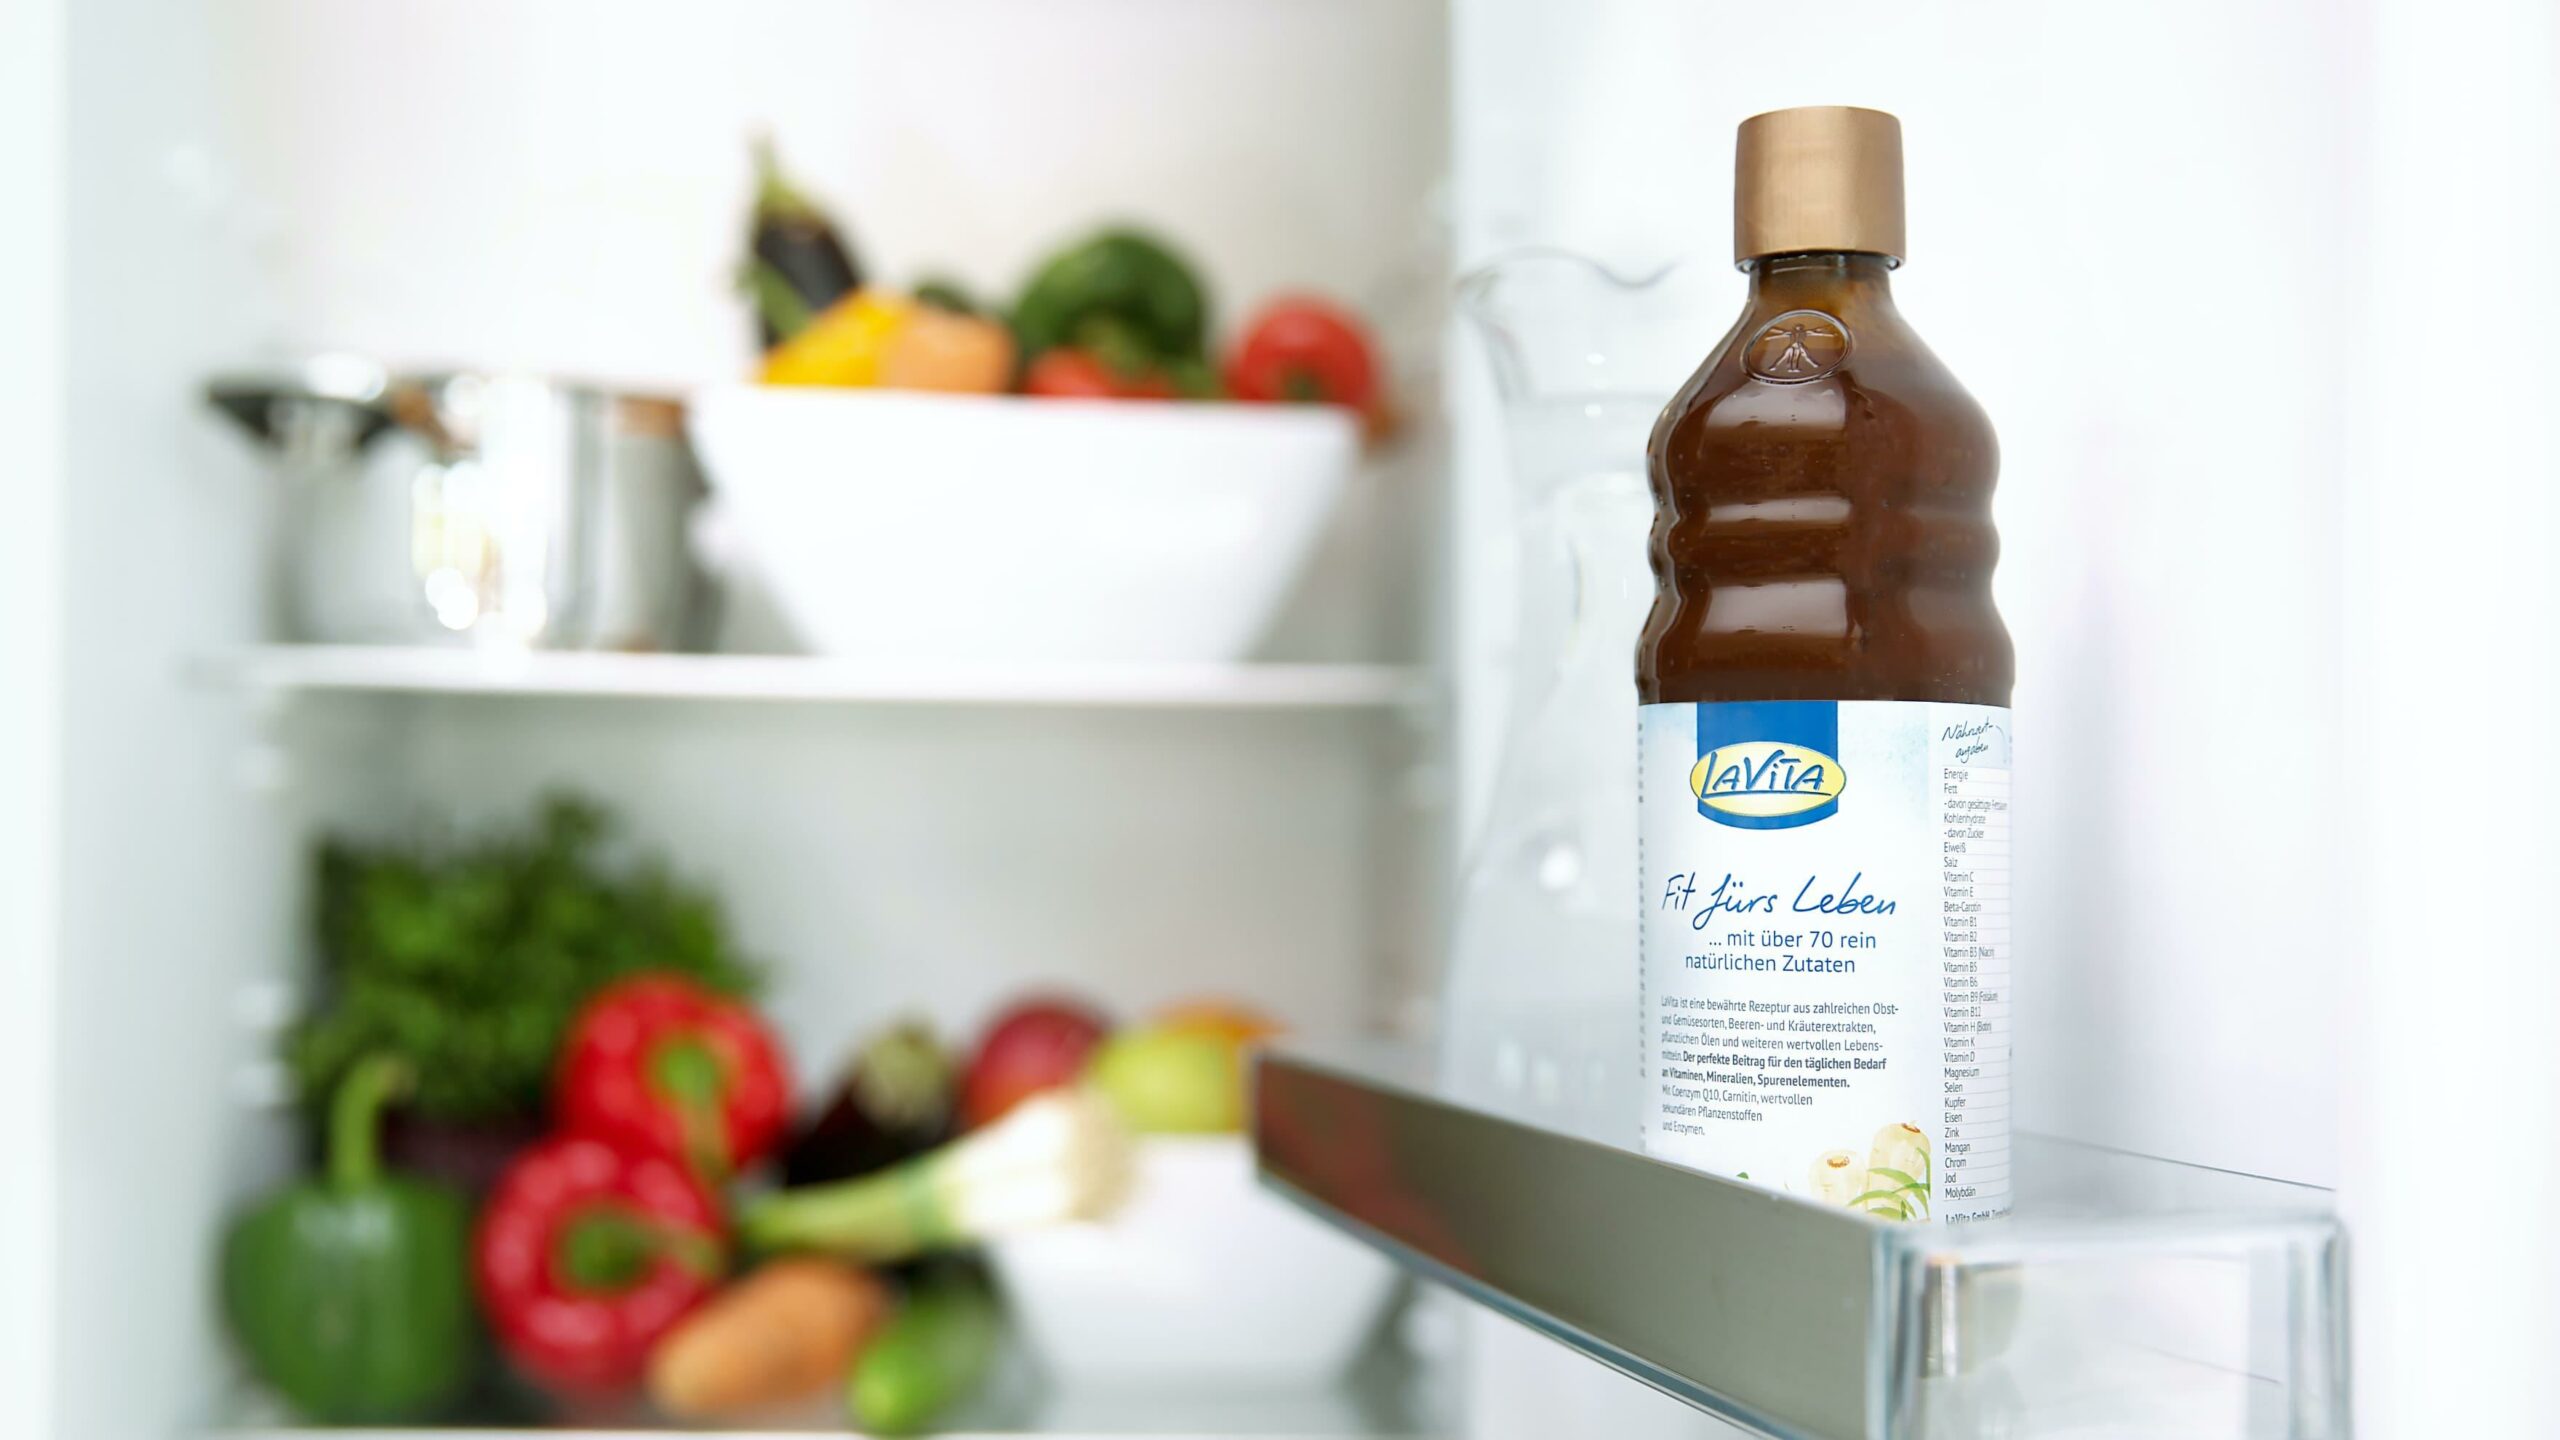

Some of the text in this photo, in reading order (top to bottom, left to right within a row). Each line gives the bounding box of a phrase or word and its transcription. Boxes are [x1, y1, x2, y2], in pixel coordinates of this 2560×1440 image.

[1944, 768, 1968, 782] Energie
[1944, 783, 1958, 794] Fett
[1948, 799, 1966, 809] davon
[1944, 812, 1986, 826] Kohlenhydrate
[1948, 828, 1966, 838] davon
[1967, 828, 1984, 838] Zucker
[1944, 842, 1966, 853] Eiweiß
[1944, 856, 1958, 867] Salz
[1944, 872, 1974, 882] Vitamin C
[1944, 886, 1974, 897] Vitamin E
[1661, 872, 1896, 930] Fit fürs Leben
[1944, 916, 1977, 927] Vitamin B1
[1727, 930, 1755, 947] mit
[1762, 930, 1802, 948] über
[1810, 931, 1833, 948] 70
[1840, 932, 1876, 949] rein
[1944, 931, 1977, 942] Vitamin B2
[1944, 946, 1968, 957] Vitamin
[1970, 946, 1977, 957] B3
[1686, 953, 1855, 972] natürlichen Zutaten
[1944, 962, 1977, 972] Vitamin B5
[1944, 976, 1978, 987] Vitamin B6
[1944, 992, 1968, 1002] Vitamin
[1970, 992, 1978, 1002] B9
[1690, 998, 1705, 1009] eine
[1707, 999, 1746, 1011] bewährte
[1749, 1000, 1791, 1015] Rezeptur
[1793, 1005, 1810, 1014] aus
[1813, 1002, 1870, 1014] zahlreichen
[1873, 1003, 1899, 1015] Obst-
[1944, 1007, 1981, 1017] Vitamin B12
[1661, 1014, 1876, 1035] und Gemüsesorten, Beeren- und Kräuterextrakten,
[1944, 1022, 1968, 1032] Vitamin
[1970, 1022, 1975, 1032] H
[1701, 1032, 1720, 1046] Ölen
[1723, 1036, 1739, 1047] und
[1742, 1037, 1783, 1049] weiteren
[1786, 1040, 1841, 1051] wertvollen
[1844, 1040, 1883, 1051] Lebens-
[1944, 1037, 1975, 1047] Vitamin K
[1683, 1051, 1695, 1062] Der
[1697, 1053, 1730, 1065] perfekte
[1732, 1054, 1765, 1069] Beitrag
[1768, 1056, 1782, 1067] für
[1784, 1057, 1802, 1068] den
[1805, 1057, 1851, 1071] täglichen
[1854, 1058, 1887, 1069] Bedarf
[1944, 1051, 1975, 1062] Vitamin D
[1669, 1067, 1705, 1083] Vitaminen,
[1706, 1071, 1756, 1086] Mineralien,
[1757, 1074, 1850, 1088] Spurenelementen.
[1944, 1067, 1979, 1080] Magnesium
[1944, 1082, 1962, 1093] Selen
[1672, 1085, 1701, 1101] Coenzym
[1703, 1088, 1721, 1102] Q10,
[1723, 1090, 1759, 1104] Carnitin,
[1761, 1094, 1813, 1105] wertvollen
[1944, 1097, 1966, 1110] Kupfer
[1698, 1106, 1762, 1121] Pflanzenstoffen
[1945, 1112, 1962, 1123] Eisen
[1945, 1127, 1960, 1138] Zink
[1945, 1142, 1970, 1155] Mangan
[1945, 1157, 1966, 1168] Chrom
[1945, 1172, 1956, 1183] Jod
[1945, 1186, 1976, 1200] Molybdän
